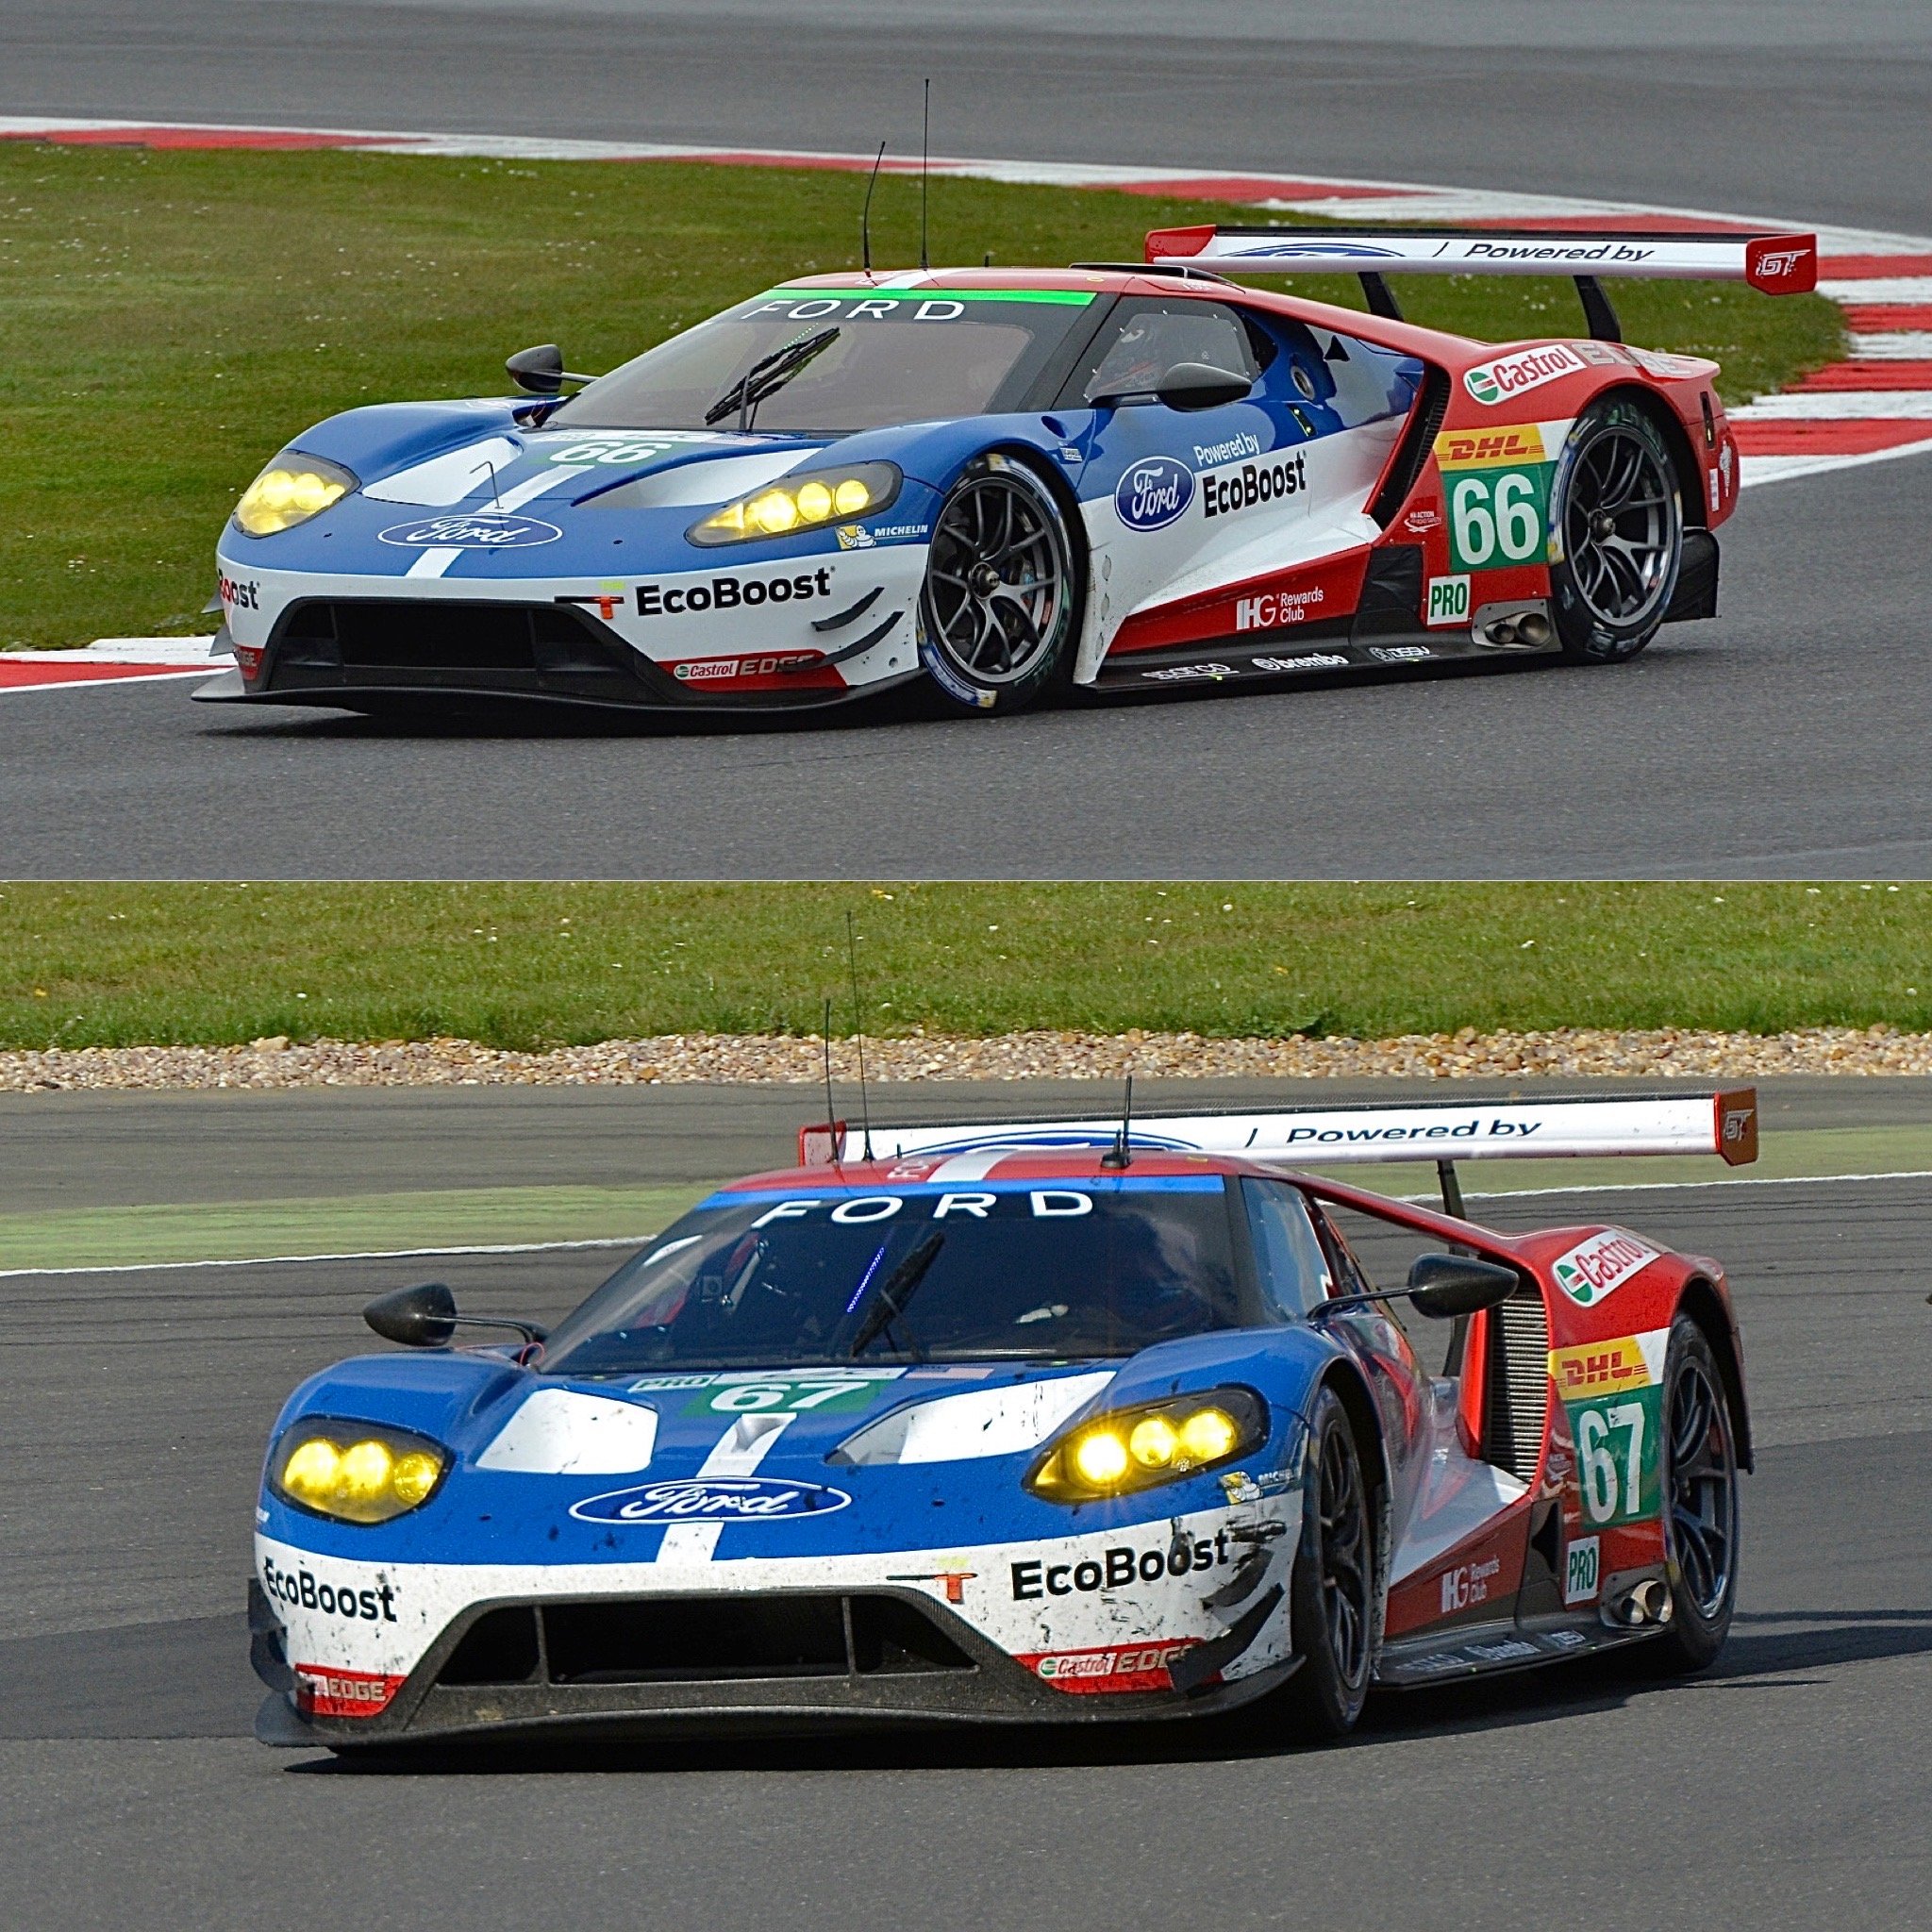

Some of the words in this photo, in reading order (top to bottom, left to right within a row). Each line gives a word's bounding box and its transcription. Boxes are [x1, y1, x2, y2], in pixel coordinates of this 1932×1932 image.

[1463, 243, 1610, 259] Powered
[1611, 244, 1655, 261] by
[1756, 249, 1811, 276] GT
[740, 299, 965, 320] FORD
[1492, 347, 1577, 392] Castrol
[549, 441, 672, 463] 66
[1192, 434, 1244, 467] Powered
[1243, 432, 1260, 456] by
[1448, 435, 1529, 461] DHL
[1131, 466, 1180, 520] Ford
[1202, 451, 1306, 519] EcoBoost
[406, 518, 531, 544] Ford
[874, 525, 928, 538] MICHELIN
[1453, 473, 1541, 565] 66
[635, 566, 832, 616] EcoBoost
[1280, 586, 1324, 607] Rewards
[1429, 582, 1468, 618] PRO
[1236, 594, 1276, 631] IHG
[1279, 606, 1305, 624] Club
[690, 663, 735, 677] Castrol
[1286, 1120, 1480, 1143] Powered
[1489, 1119, 1542, 1138] by
[1724, 1108, 1755, 1141] GT
[751, 1190, 1094, 1228] FORD
[1574, 1234, 1651, 1289] Castrol
[637, 1376, 703, 1390] PRO
[1561, 1351, 1633, 1387] DHL
[710, 1381, 870, 1411] 67
[1579, 1402, 1645, 1524] 67
[619, 1482, 800, 1520] Ford
[1010, 1527, 1229, 1601] EcoBoost
[1567, 1546, 1597, 1593] PRO
[263, 1556, 398, 1623] EcoBoost
[1058, 1654, 1113, 1675] Castrol
[327, 1677, 387, 1702] EDGE
